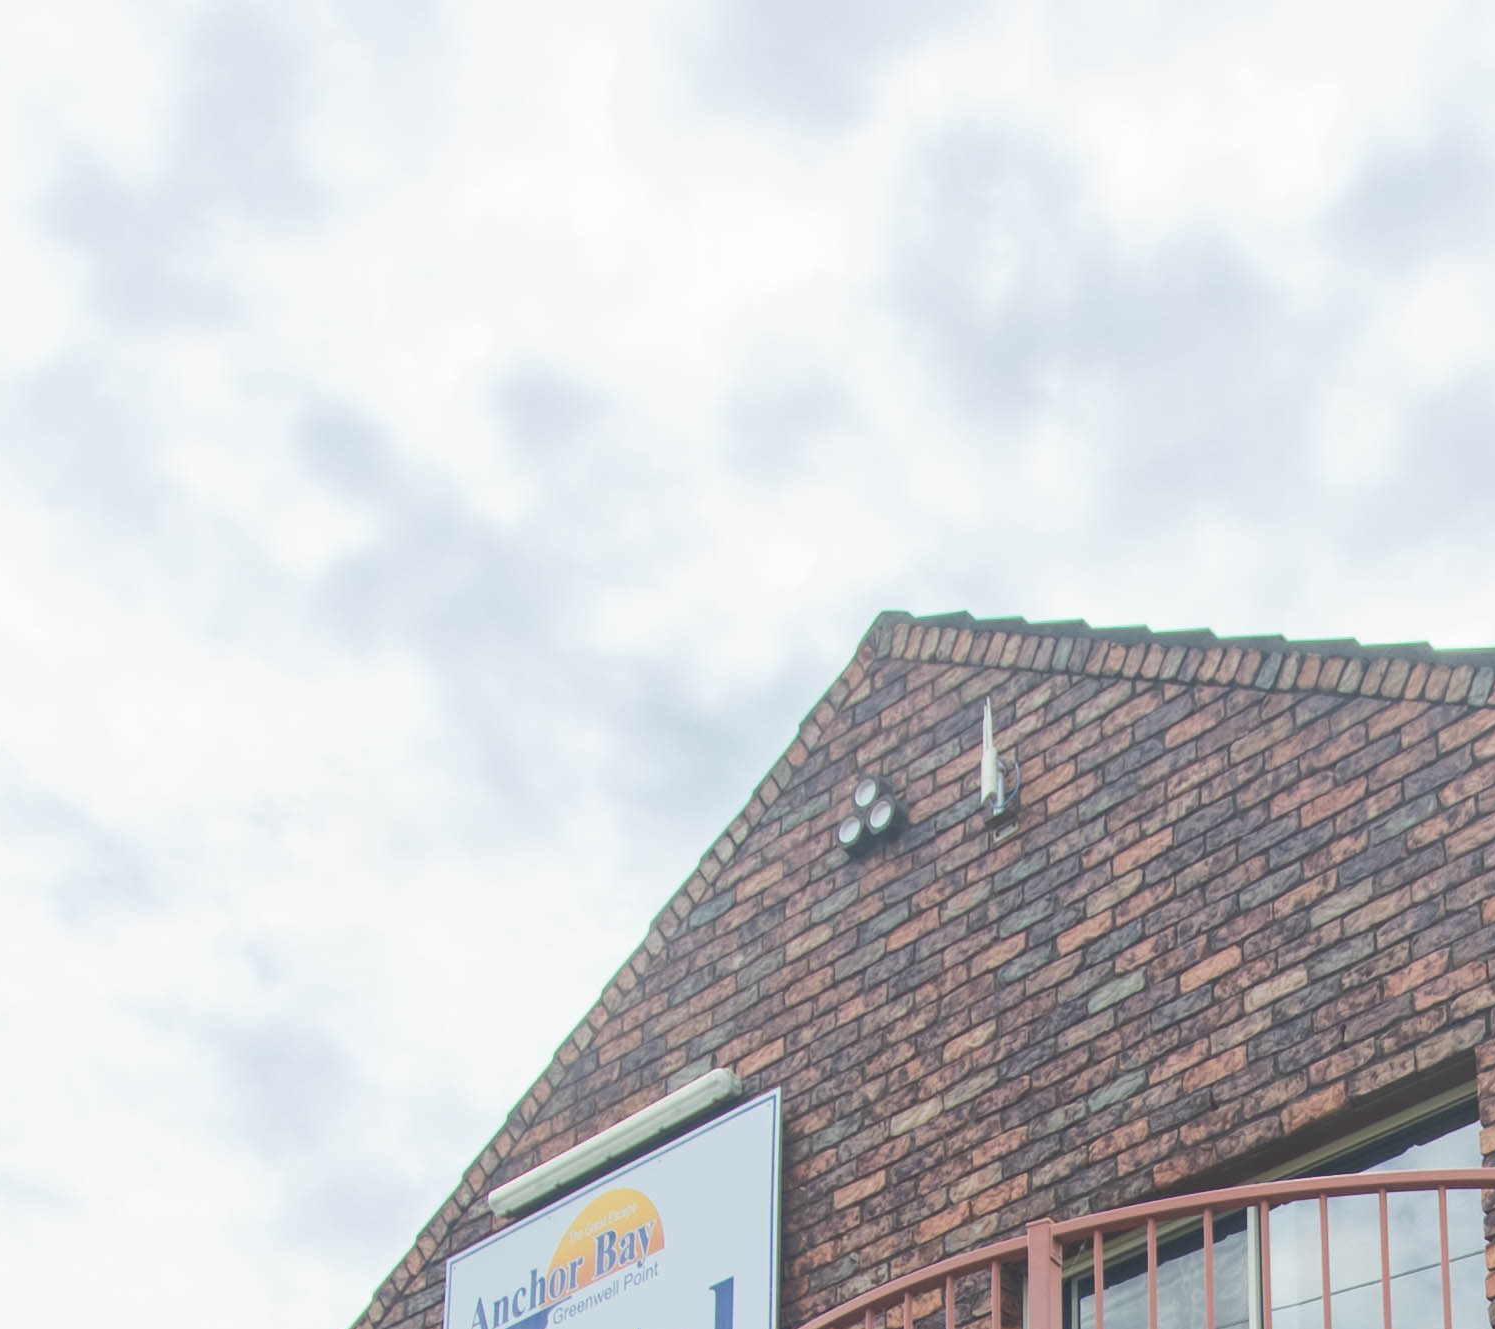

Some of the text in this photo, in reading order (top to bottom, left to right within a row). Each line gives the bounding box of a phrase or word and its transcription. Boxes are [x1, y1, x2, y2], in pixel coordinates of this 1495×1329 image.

[594, 1220, 655, 1278] Bay
[552, 1261, 659, 1325] Greenwell Point
